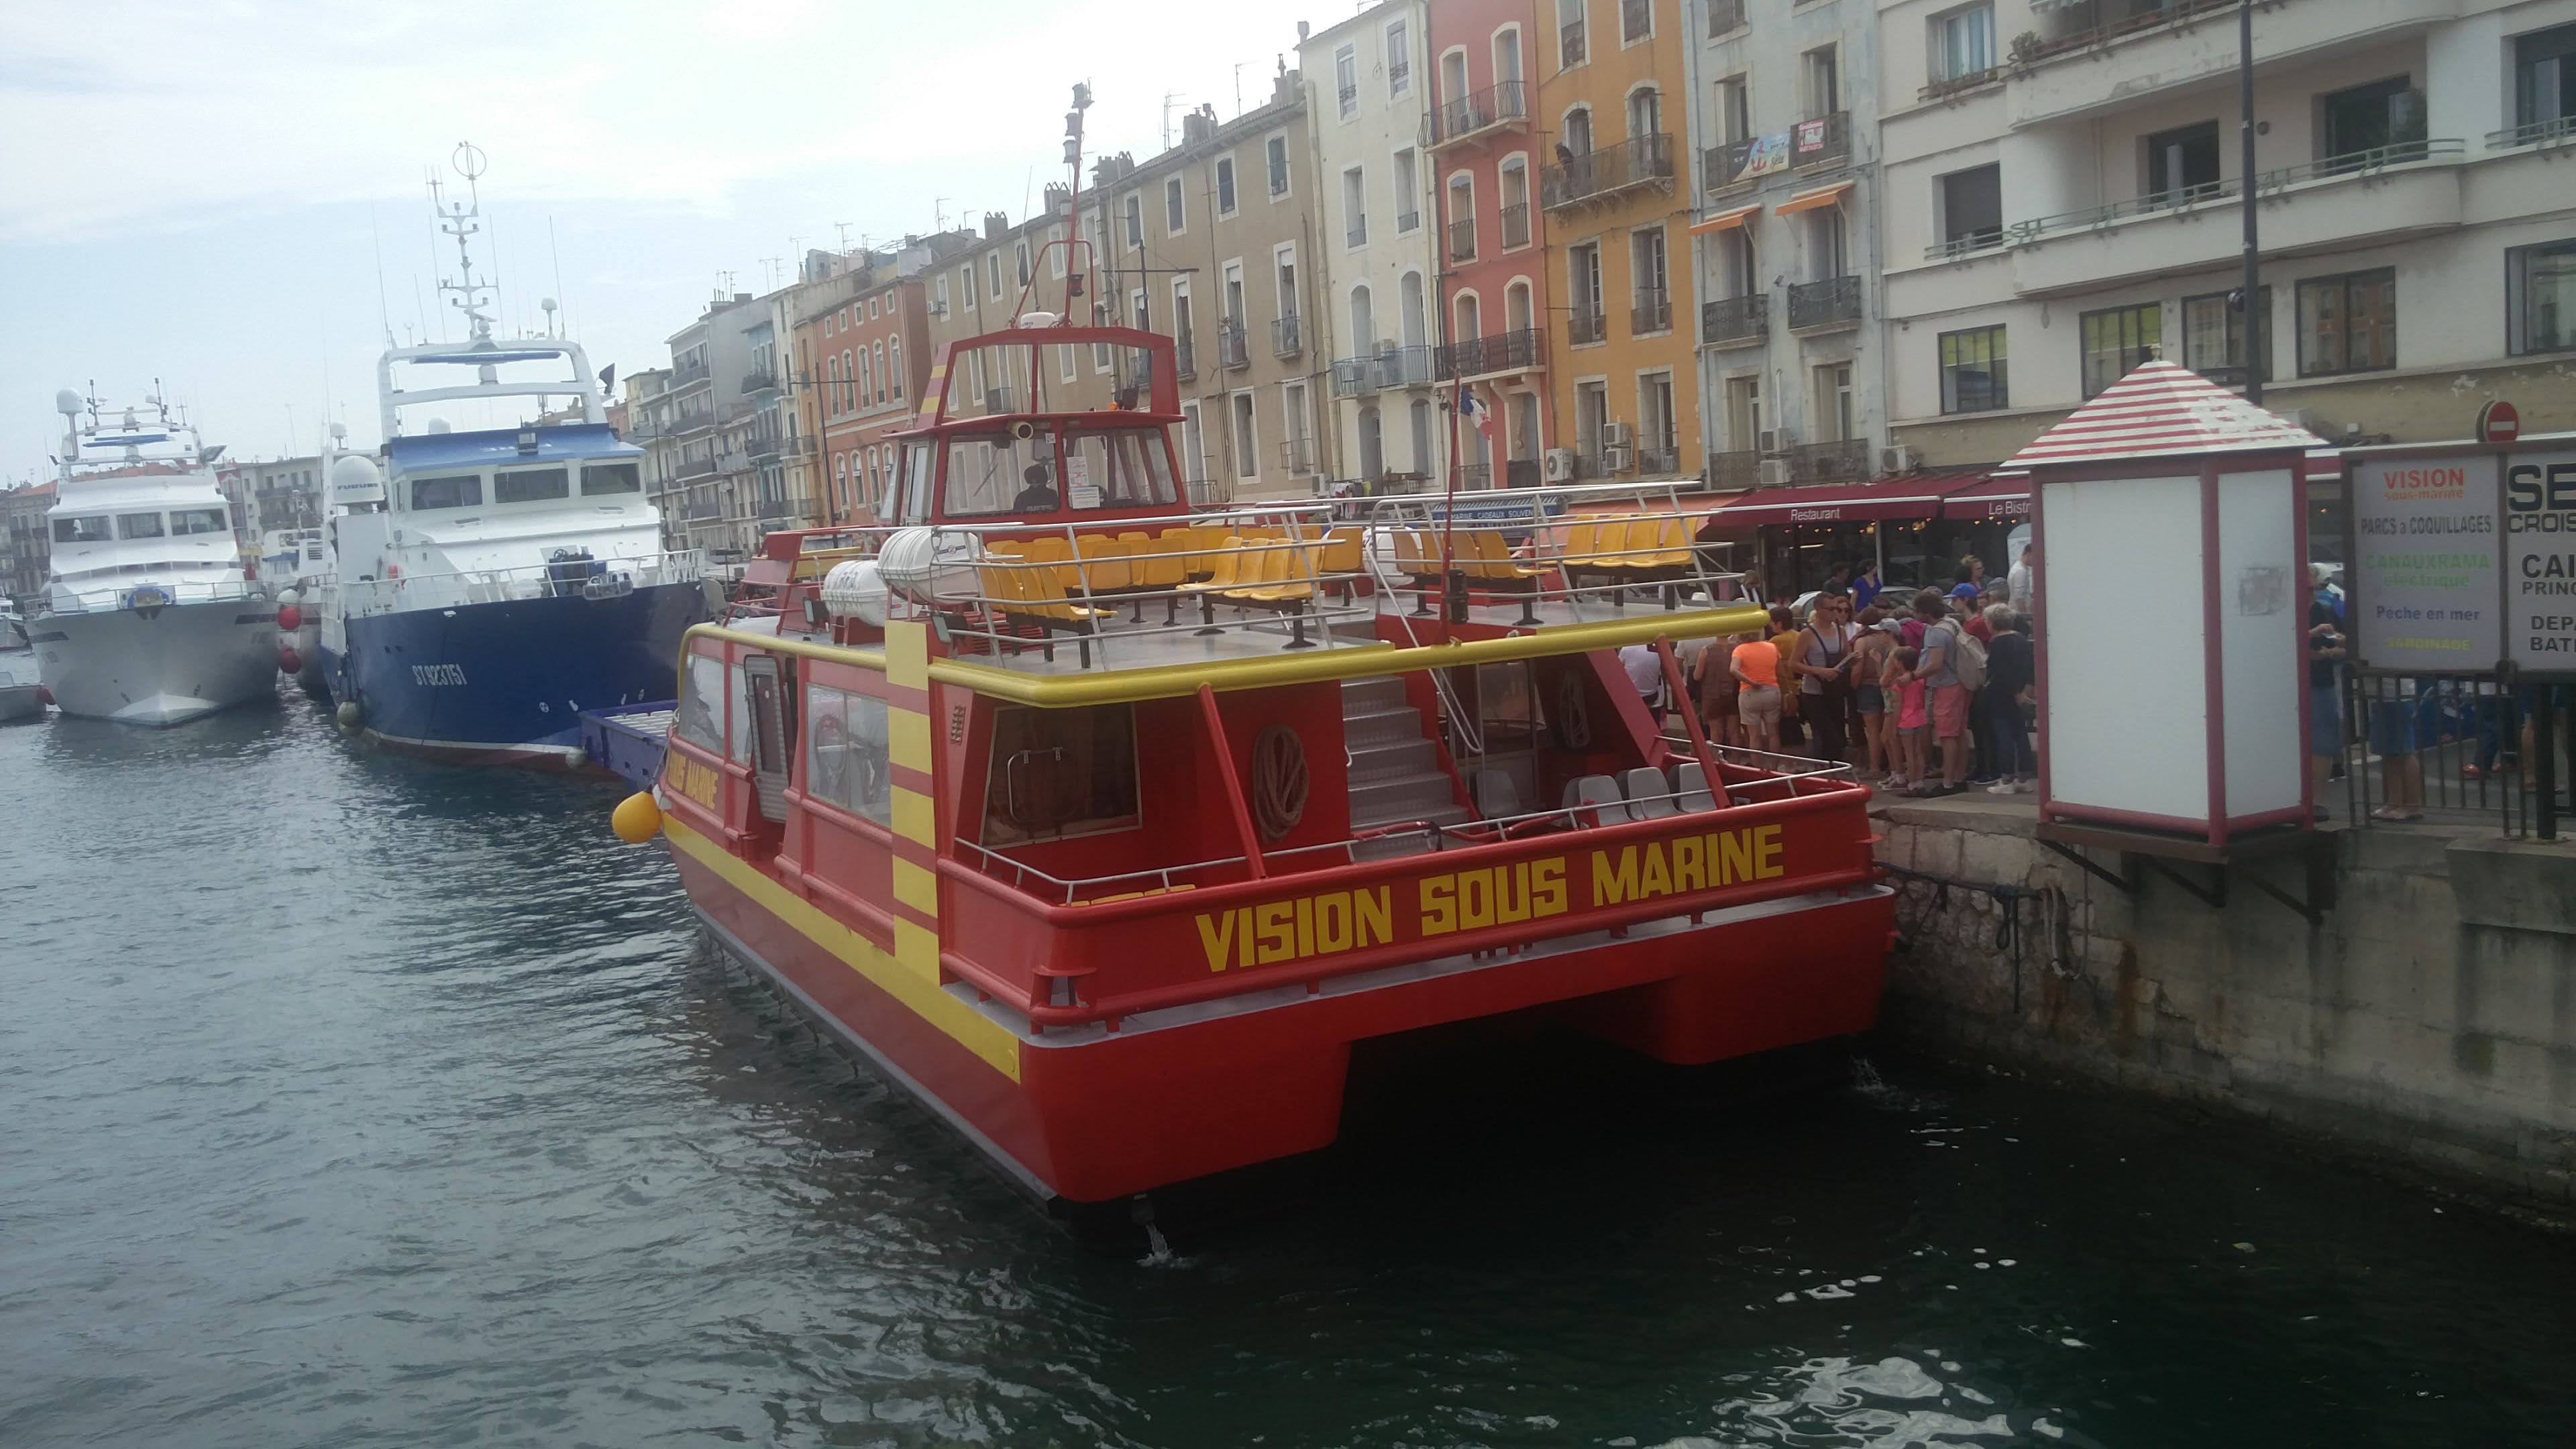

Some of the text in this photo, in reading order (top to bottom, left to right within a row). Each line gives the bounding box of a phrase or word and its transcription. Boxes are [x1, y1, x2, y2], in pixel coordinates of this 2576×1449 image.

[2383, 467, 2465, 490] VISION
[2508, 463, 2576, 512] SE
[1477, 511, 1505, 519] CADEAUX
[1507, 508, 1542, 519] SOUVEN
[1790, 507, 1841, 521] Restaurant
[1988, 500, 2031, 515] Le Bistr
[2361, 517, 2397, 535] PARCS
[2409, 515, 2491, 535] COQUILLAGES
[2366, 553, 2491, 570] CANAUXRAMA
[2522, 554, 2576, 578] CAI
[2376, 605, 2480, 621] Peche en mer
[2531, 616, 2576, 631] DEP
[2530, 637, 2576, 652] BAT
[1195, 824, 1784, 973] VISION SOUS MARINE
